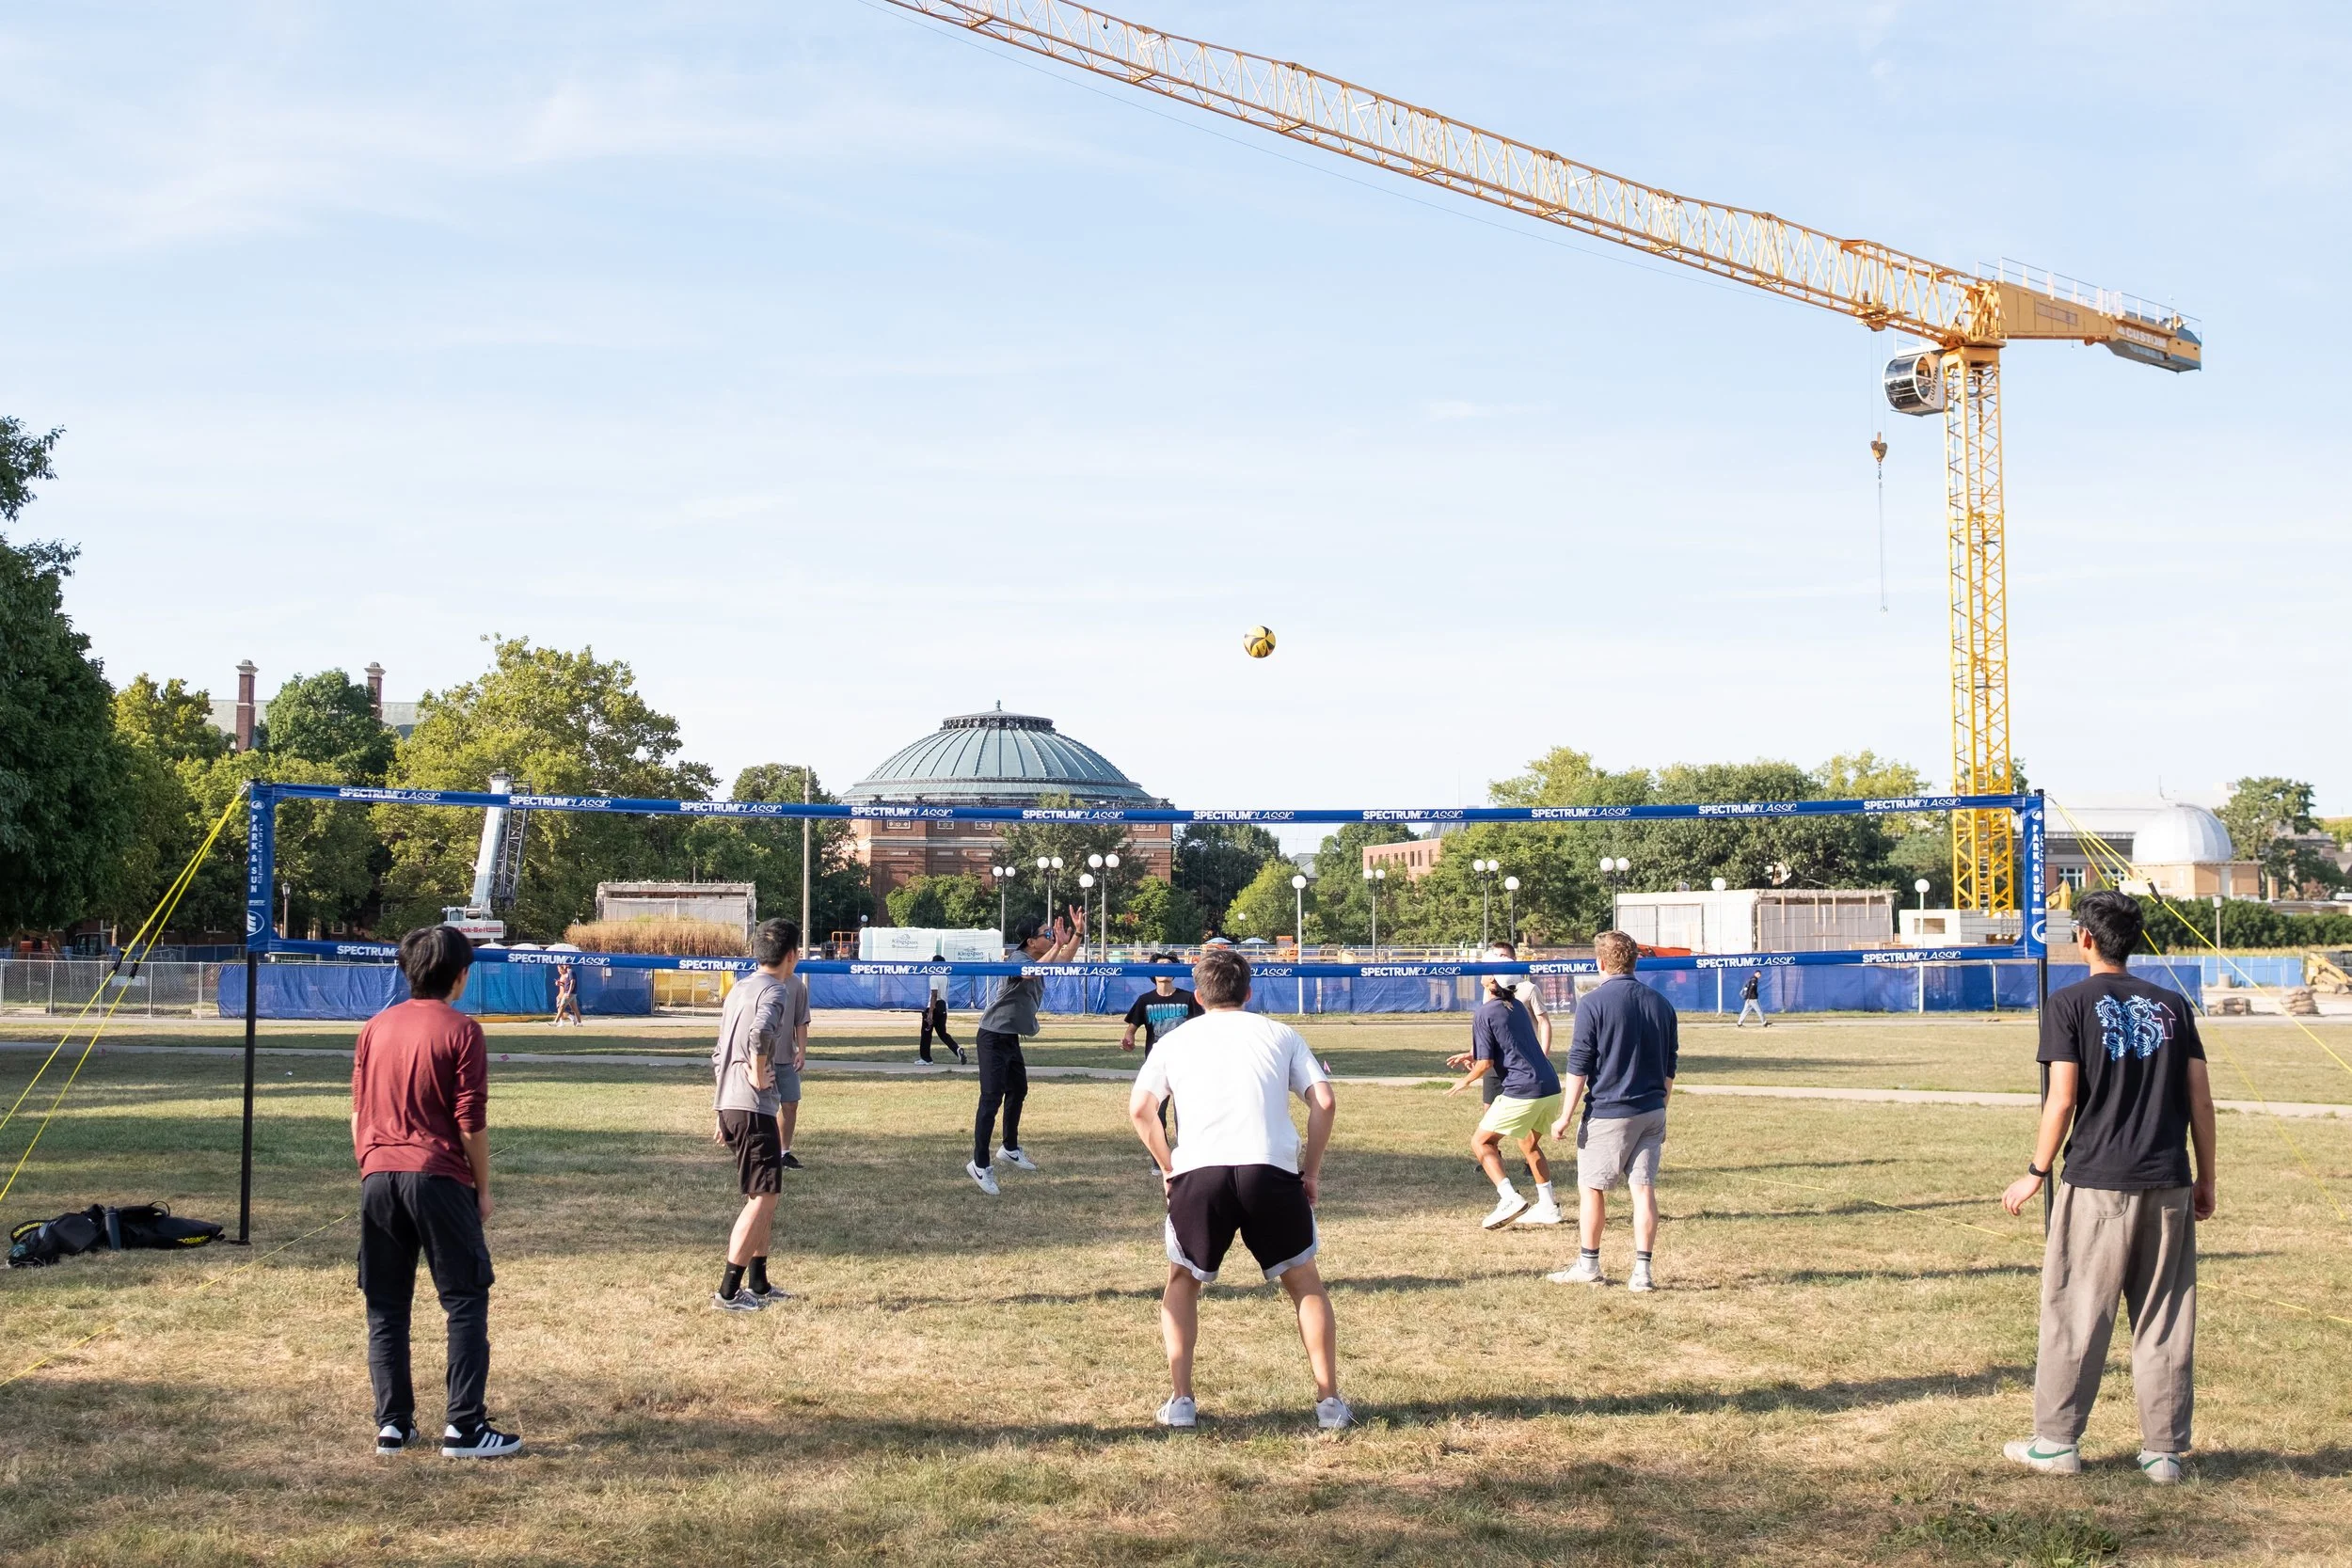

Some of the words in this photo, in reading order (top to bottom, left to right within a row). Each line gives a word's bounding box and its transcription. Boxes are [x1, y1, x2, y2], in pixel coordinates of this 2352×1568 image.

[2126, 326, 2168, 348] CUSTOM
[1930, 367, 1939, 401] CUSTOM
[250, 854, 258, 863] &
[2032, 863, 2040, 872] &
[2032, 875, 2041, 902] SUN
